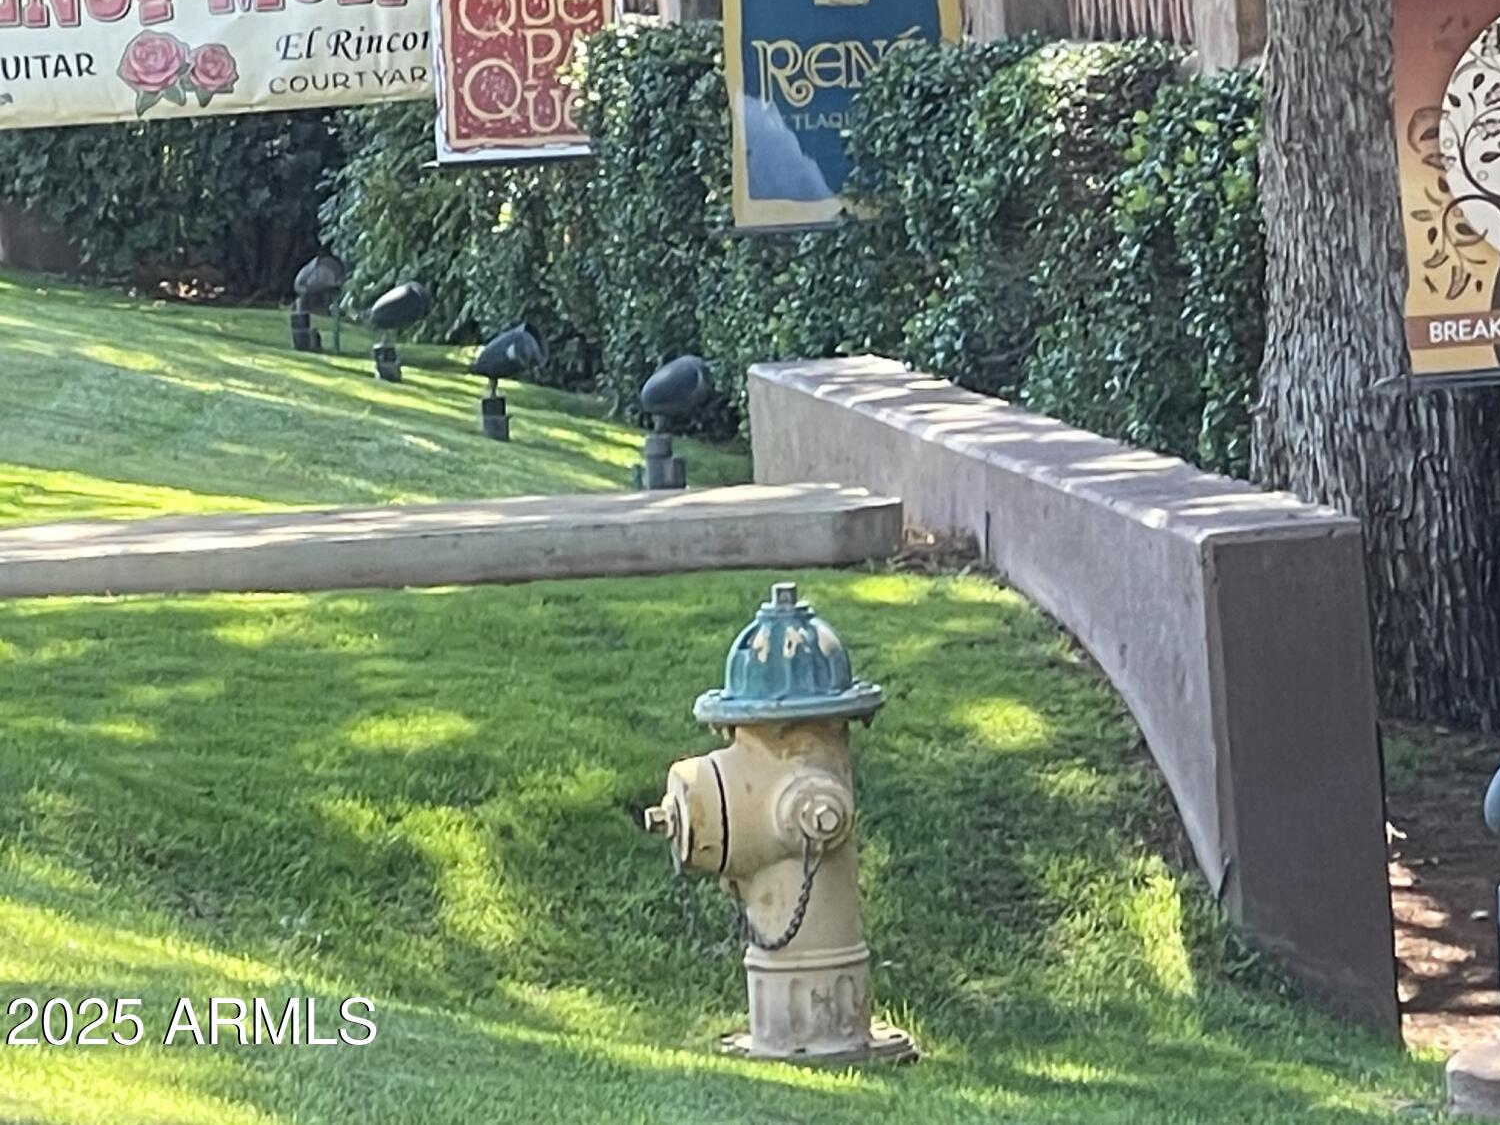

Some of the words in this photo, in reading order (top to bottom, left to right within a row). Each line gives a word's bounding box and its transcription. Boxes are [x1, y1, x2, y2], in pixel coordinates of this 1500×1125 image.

[276, 26, 322, 61] El
[1, 52, 97, 81] UITAR
[269, 66, 428, 95] COURTYAR
